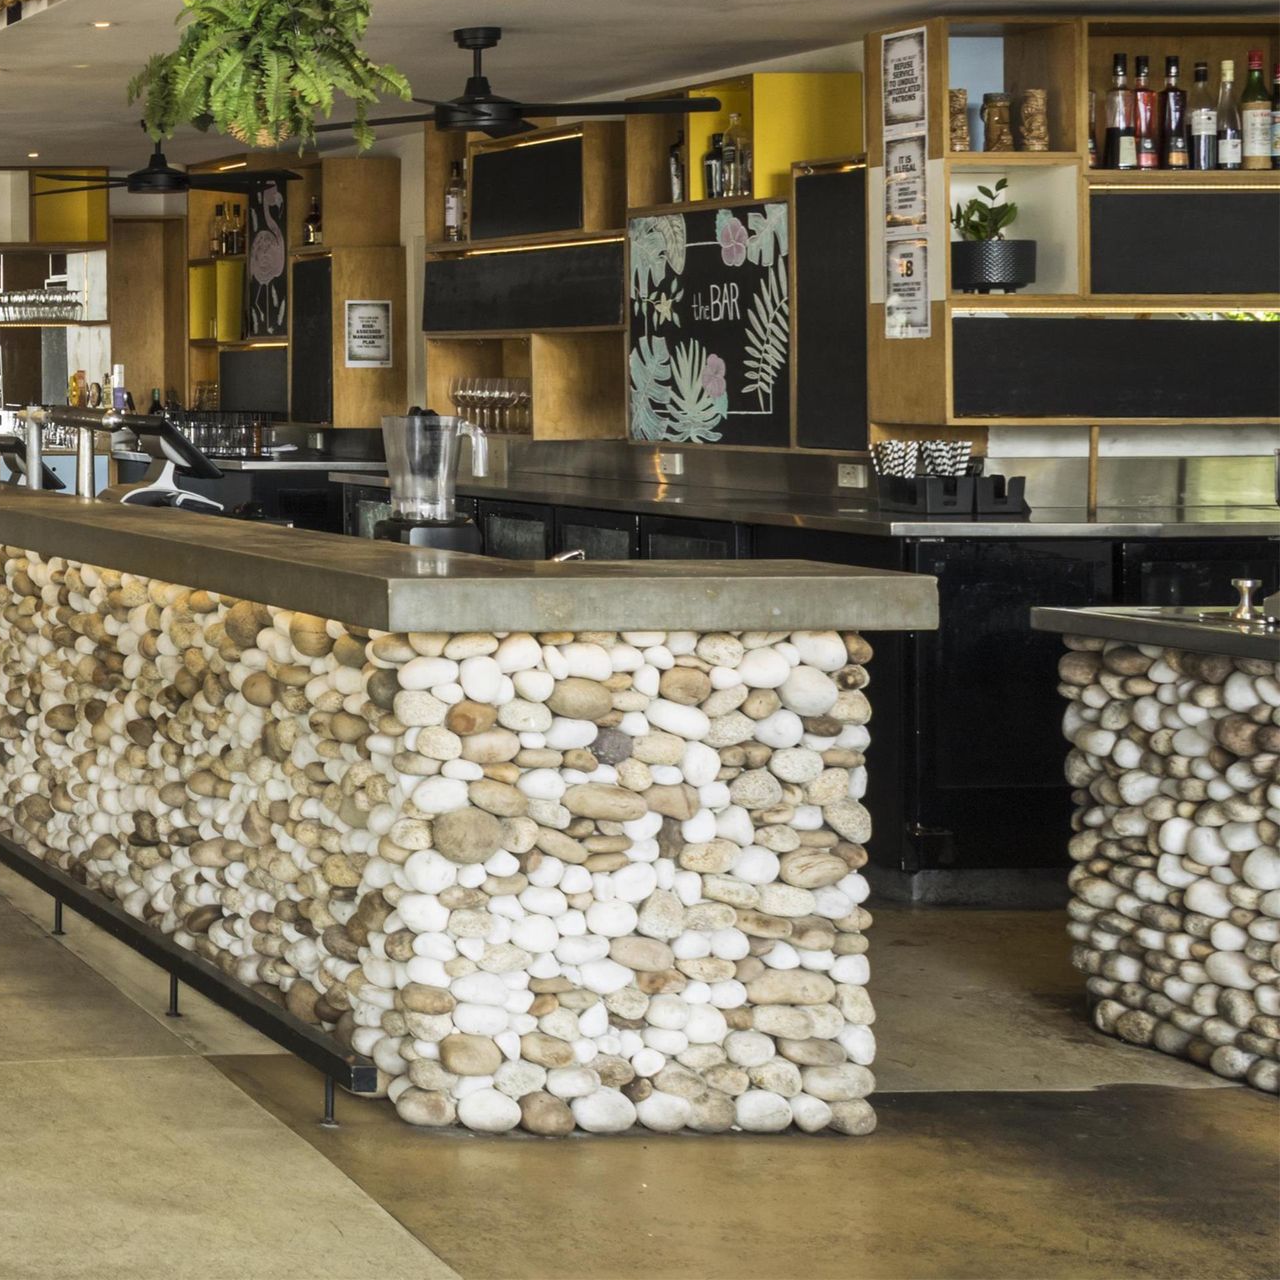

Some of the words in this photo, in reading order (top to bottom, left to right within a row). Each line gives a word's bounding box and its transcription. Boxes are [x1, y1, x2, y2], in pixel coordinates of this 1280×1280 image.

[893, 61, 914, 71] REFUSE
[892, 68, 915, 79] SERVICE
[889, 80, 896, 88] TO
[897, 76, 919, 87] UNDULY
[887, 84, 921, 96] INTOXICATED
[892, 93, 916, 104] PATRONS
[898, 156, 905, 164] IT
[905, 155, 912, 163] IS
[894, 163, 917, 173] ILLEGAL
[691, 292, 710, 321] the
[710, 282, 740, 321] BAR
